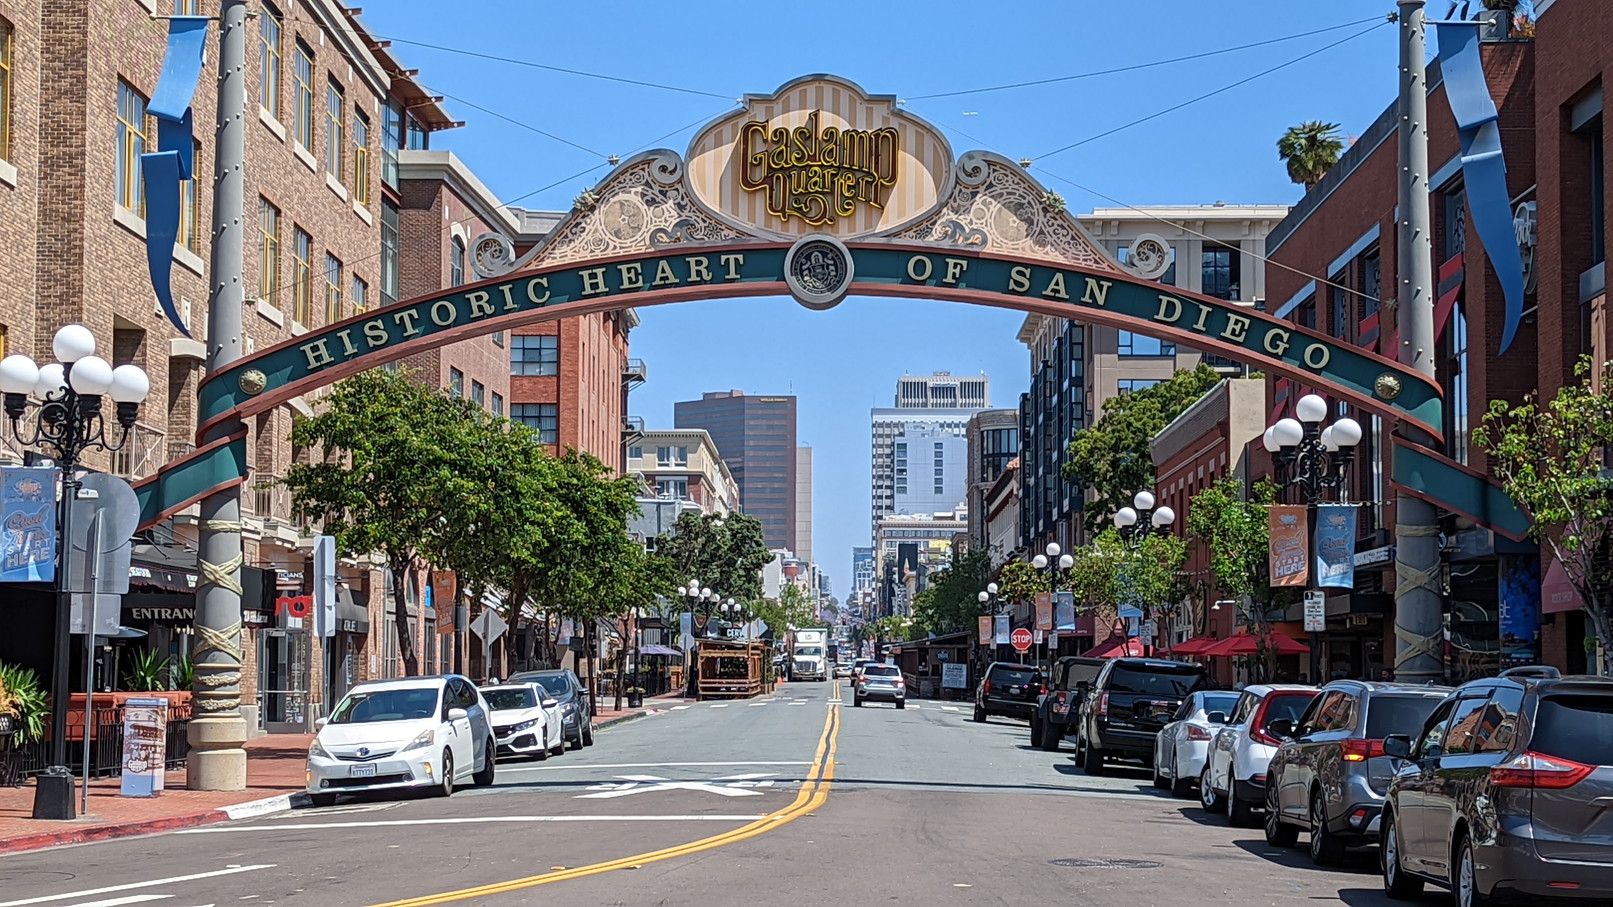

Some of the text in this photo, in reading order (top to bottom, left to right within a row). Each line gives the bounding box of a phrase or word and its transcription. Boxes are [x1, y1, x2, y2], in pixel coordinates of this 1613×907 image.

[740, 109, 899, 209] Gaslamp
[767, 166, 873, 226] Quarter
[300, 277, 551, 370] HISTORIC
[579, 253, 745, 296] HEART
[907, 254, 968, 285] OF
[1008, 266, 1113, 307] SAN
[1154, 294, 1331, 370] DIEGO
[6, 547, 50, 568] HERE
[1275, 555, 1304, 567] START
[1275, 561, 1306, 577] HERE
[1322, 563, 1351, 577] HERE
[132, 607, 197, 620] ENTRAN
[1012, 634, 1031, 643] STOP
